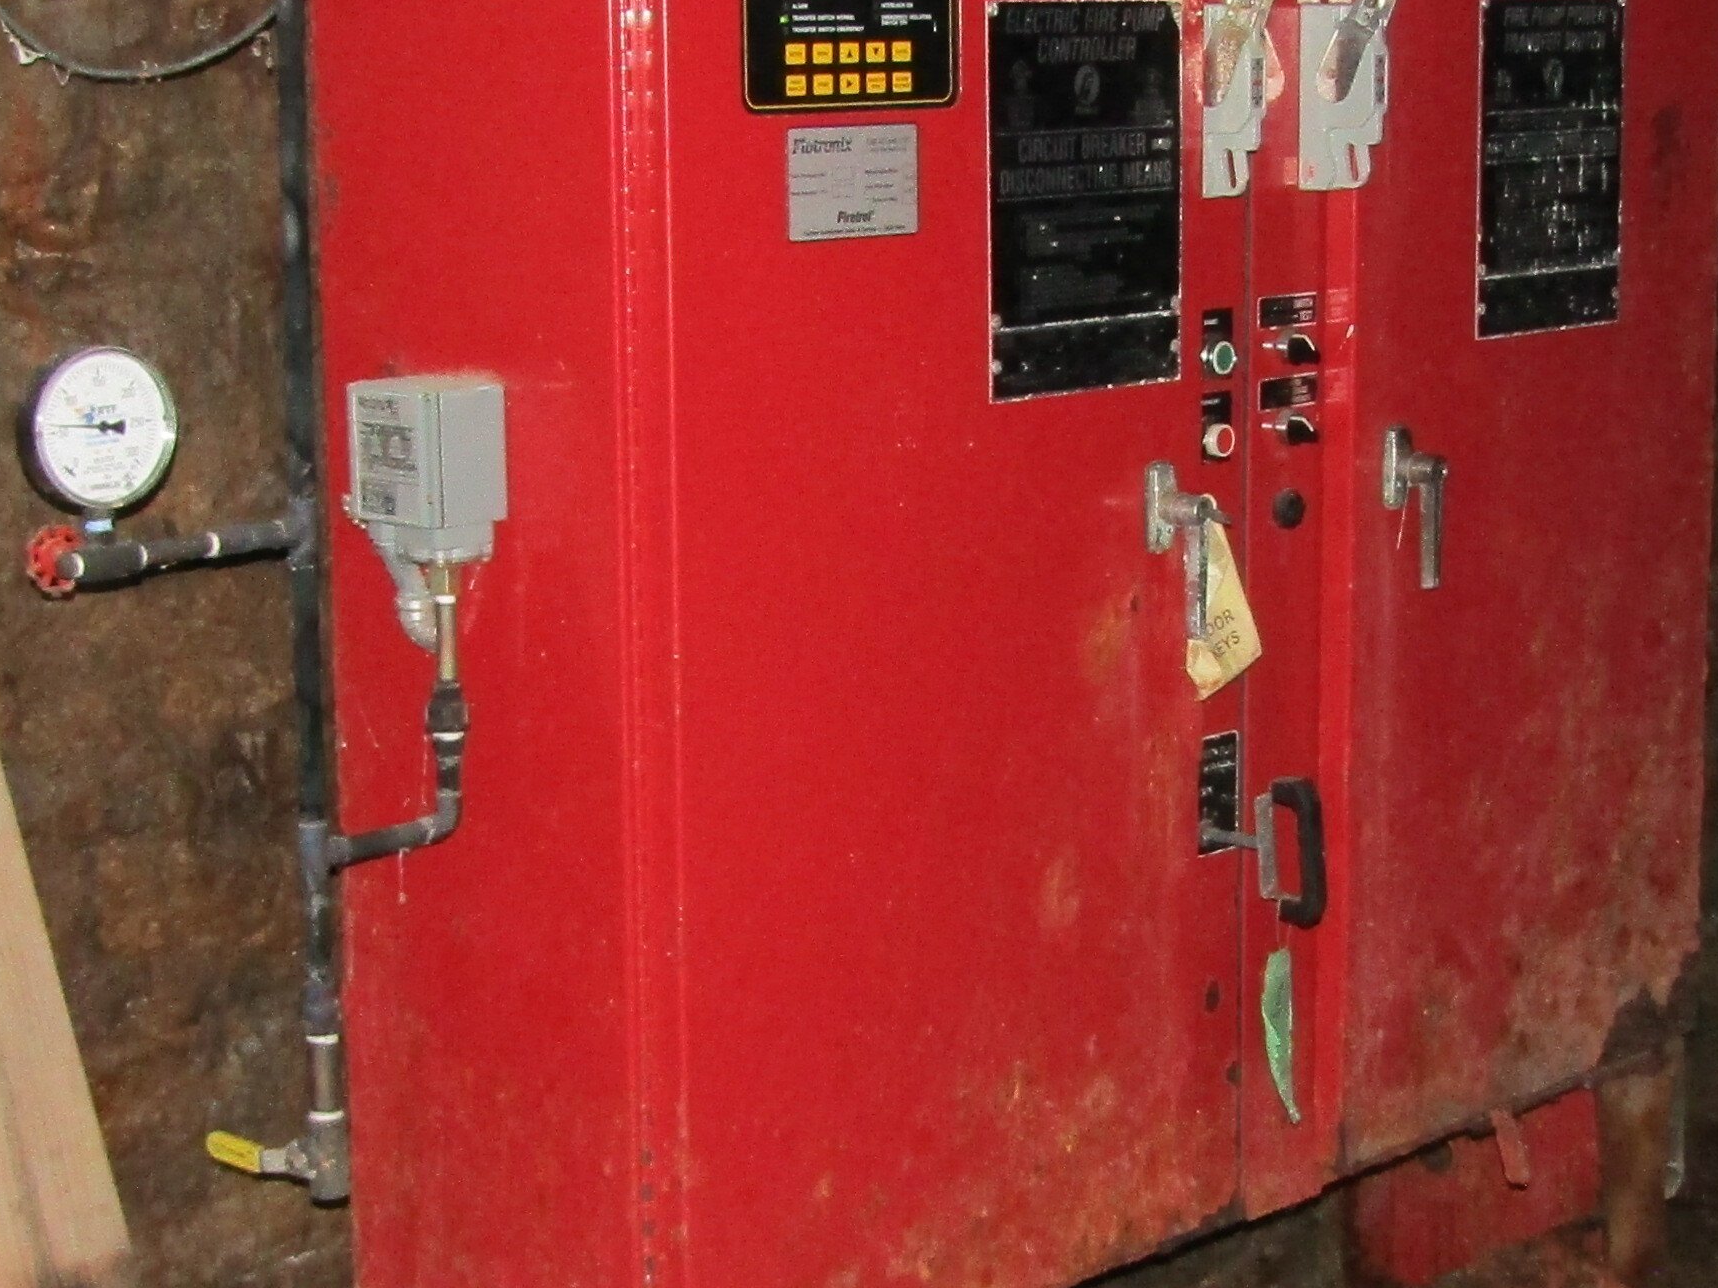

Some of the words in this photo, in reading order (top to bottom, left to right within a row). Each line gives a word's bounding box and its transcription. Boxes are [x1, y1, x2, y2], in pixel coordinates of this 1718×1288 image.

[1006, 7, 1080, 34] ELECTRIC
[1084, 7, 1117, 33] FIRE
[1122, 6, 1166, 33] PUMP
[1037, 35, 1138, 62] CONTROLLER
[1018, 137, 1077, 163] CIRCUIT
[1081, 133, 1147, 159] BREAKER
[1122, 159, 1172, 187] MEANS
[1206, 609, 1235, 637] OOR
[1212, 630, 1241, 658] EYS
